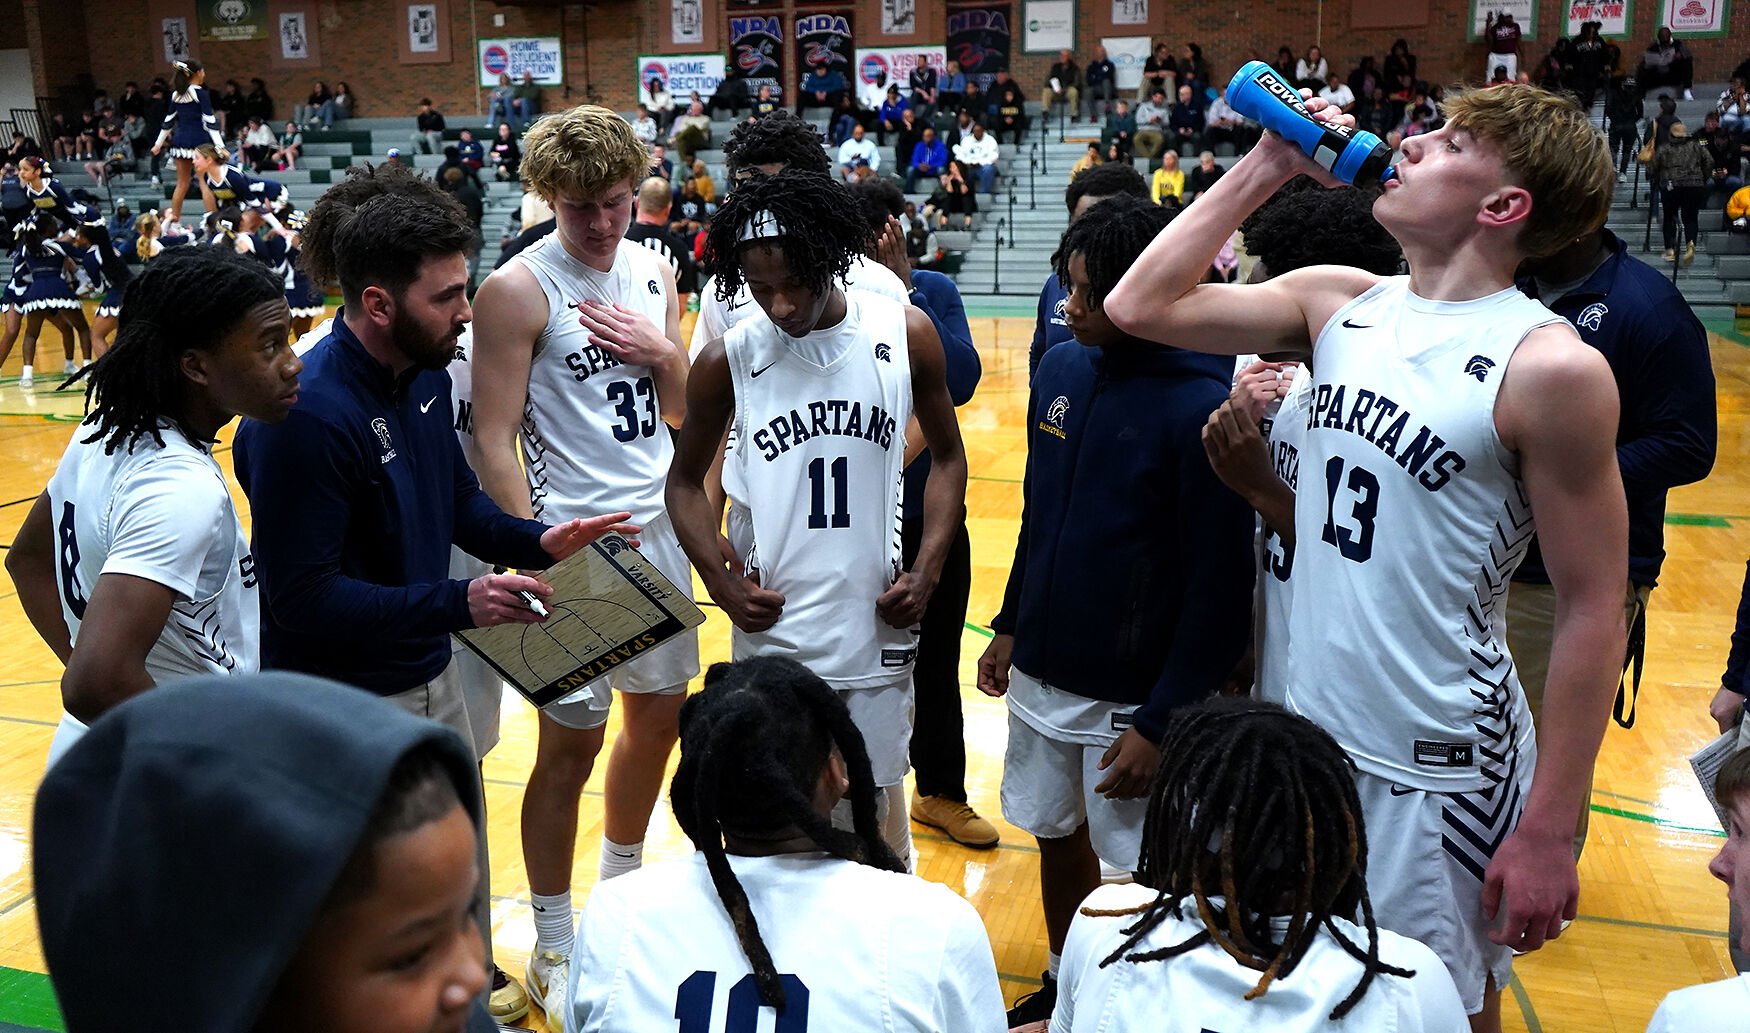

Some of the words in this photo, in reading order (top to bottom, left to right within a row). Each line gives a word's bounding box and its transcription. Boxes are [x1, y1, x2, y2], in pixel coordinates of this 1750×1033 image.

[730, 16, 783, 45] NDA
[796, 14, 852, 40] NDA
[949, 10, 1009, 37] NDA
[511, 40, 539, 52] HOME
[511, 51, 557, 62] STUDENT
[891, 52, 944, 67] VISIOR
[512, 63, 556, 74] SECTION
[669, 61, 706, 75] HOME
[1260, 73, 1352, 138] POWEDE
[606, 376, 657, 443] 33
[753, 400, 897, 462] SPARTANS
[808, 456, 850, 529] 11
[1321, 455, 1381, 564] 13
[628, 562, 672, 600] VARSITY
[556, 633, 656, 691] SPARTANS
[1455, 751, 1465, 761] M
